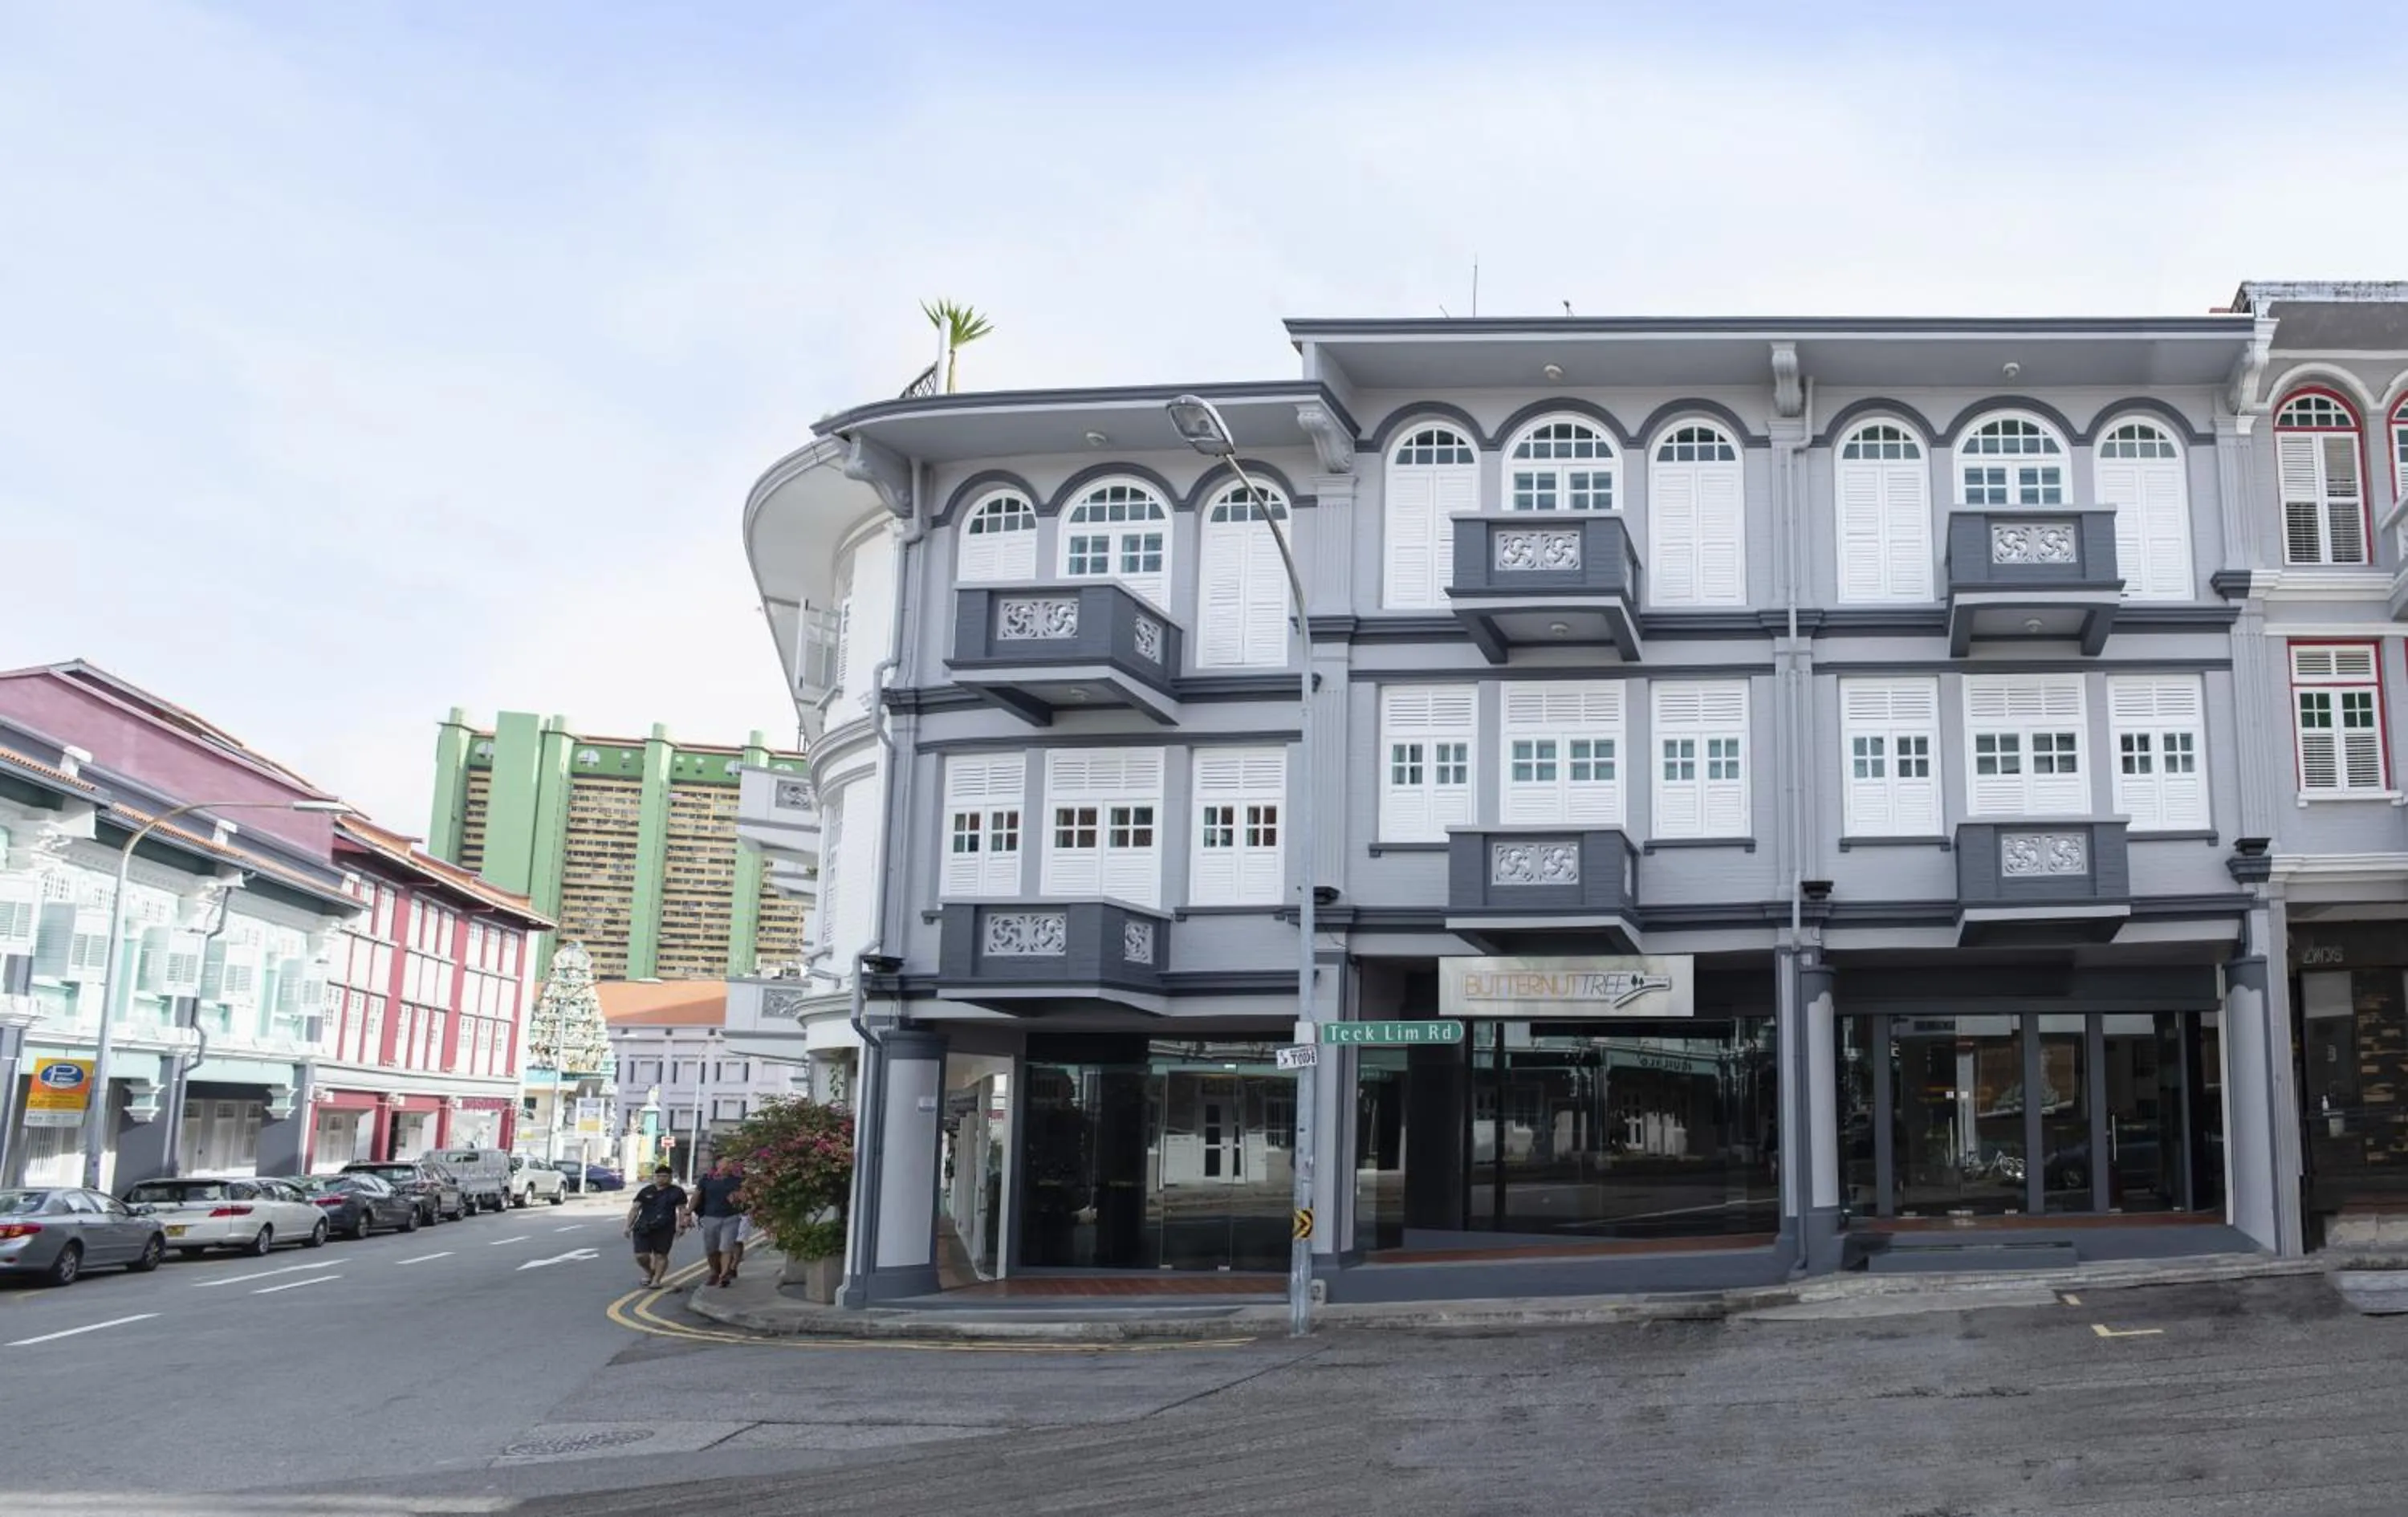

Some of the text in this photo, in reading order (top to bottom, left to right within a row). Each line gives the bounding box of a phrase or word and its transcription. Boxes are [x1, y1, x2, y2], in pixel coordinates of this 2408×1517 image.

[1329, 1023, 1452, 1042] Teck Lim Rd
